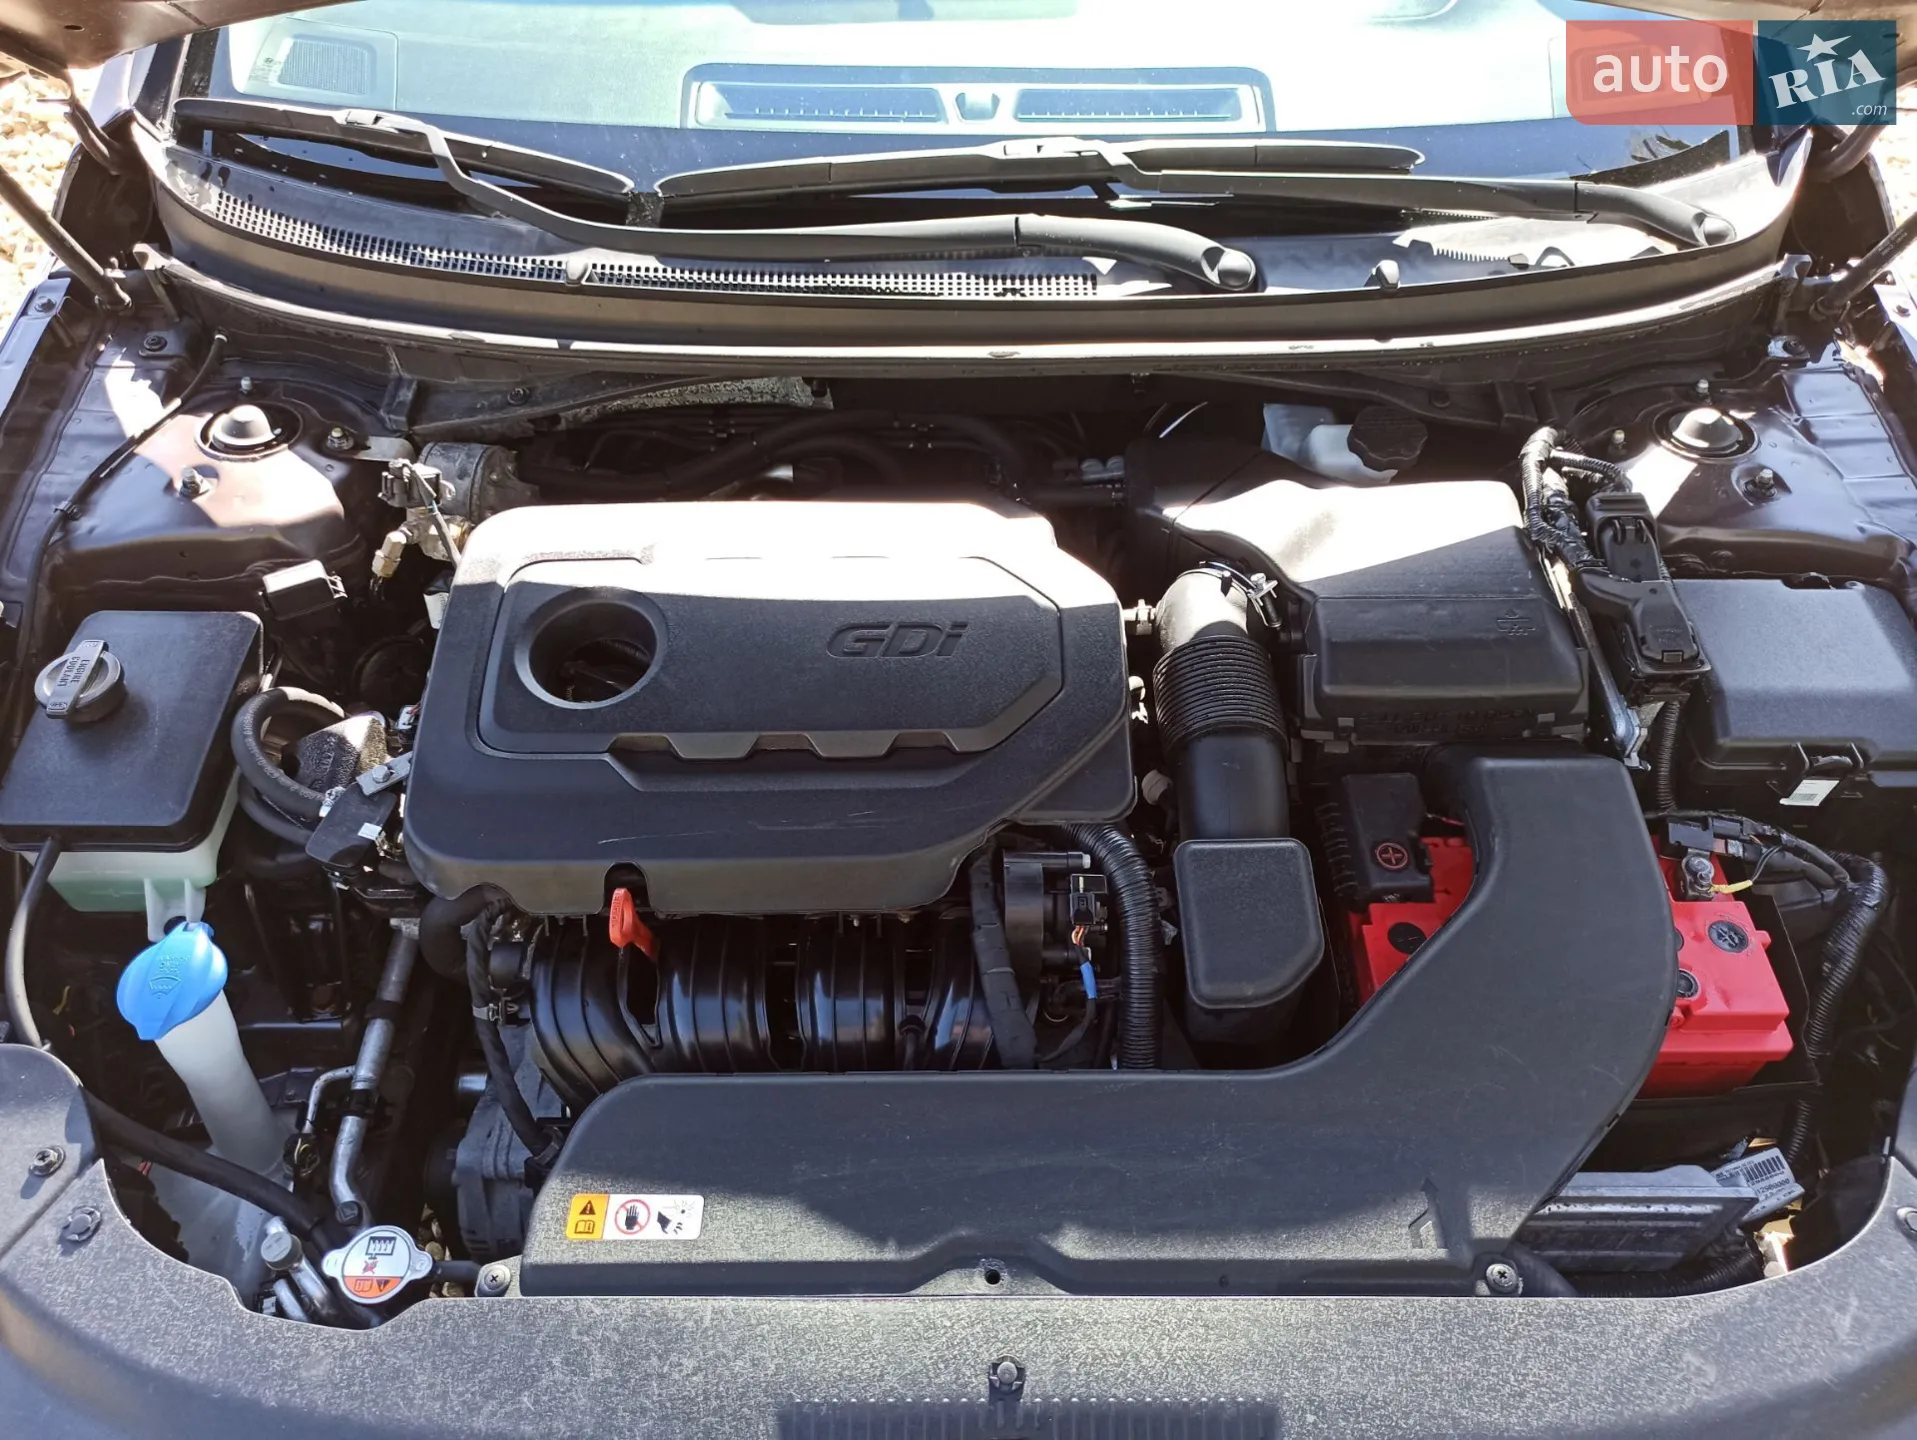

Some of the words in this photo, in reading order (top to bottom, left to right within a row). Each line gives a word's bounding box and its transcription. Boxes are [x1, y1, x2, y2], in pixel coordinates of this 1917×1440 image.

[826, 621, 969, 658] GDi
[57, 656, 81, 687] COOLANT
[70, 659, 90, 684] ENGINE
